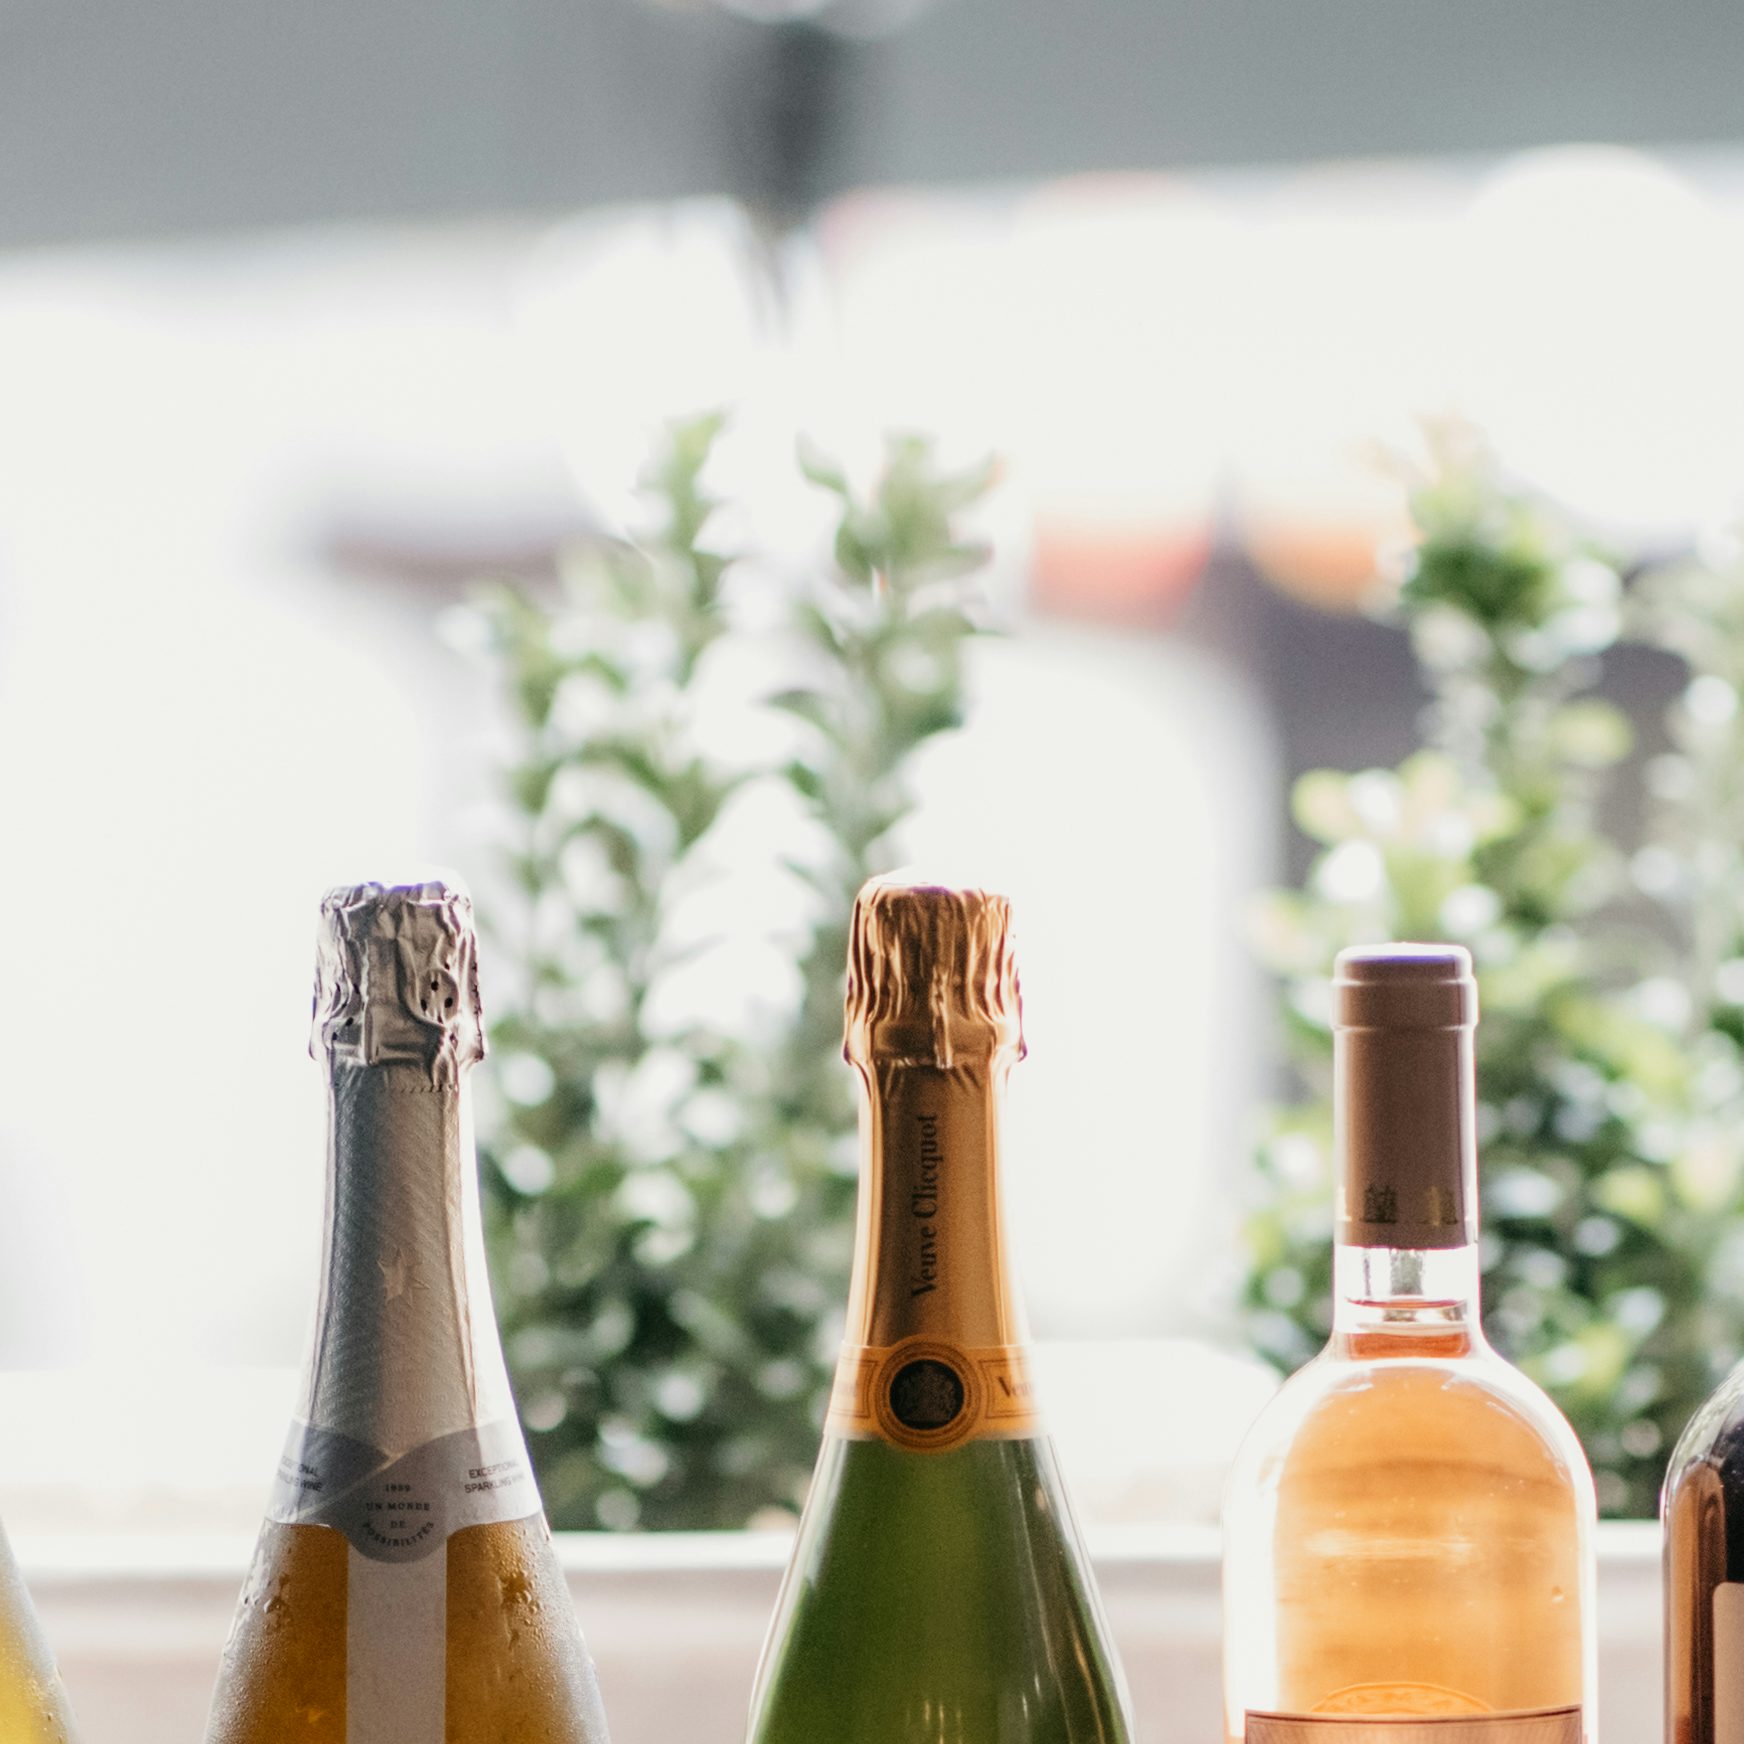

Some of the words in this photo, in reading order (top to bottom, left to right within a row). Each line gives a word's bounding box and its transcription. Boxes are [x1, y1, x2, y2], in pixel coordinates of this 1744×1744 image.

[911, 1112, 945, 1222] Clicquot
[911, 1226, 938, 1298] Veuve
[365, 1502, 383, 1512] UN
[387, 1502, 431, 1512] MONDE
[390, 1520, 406, 1529] DE
